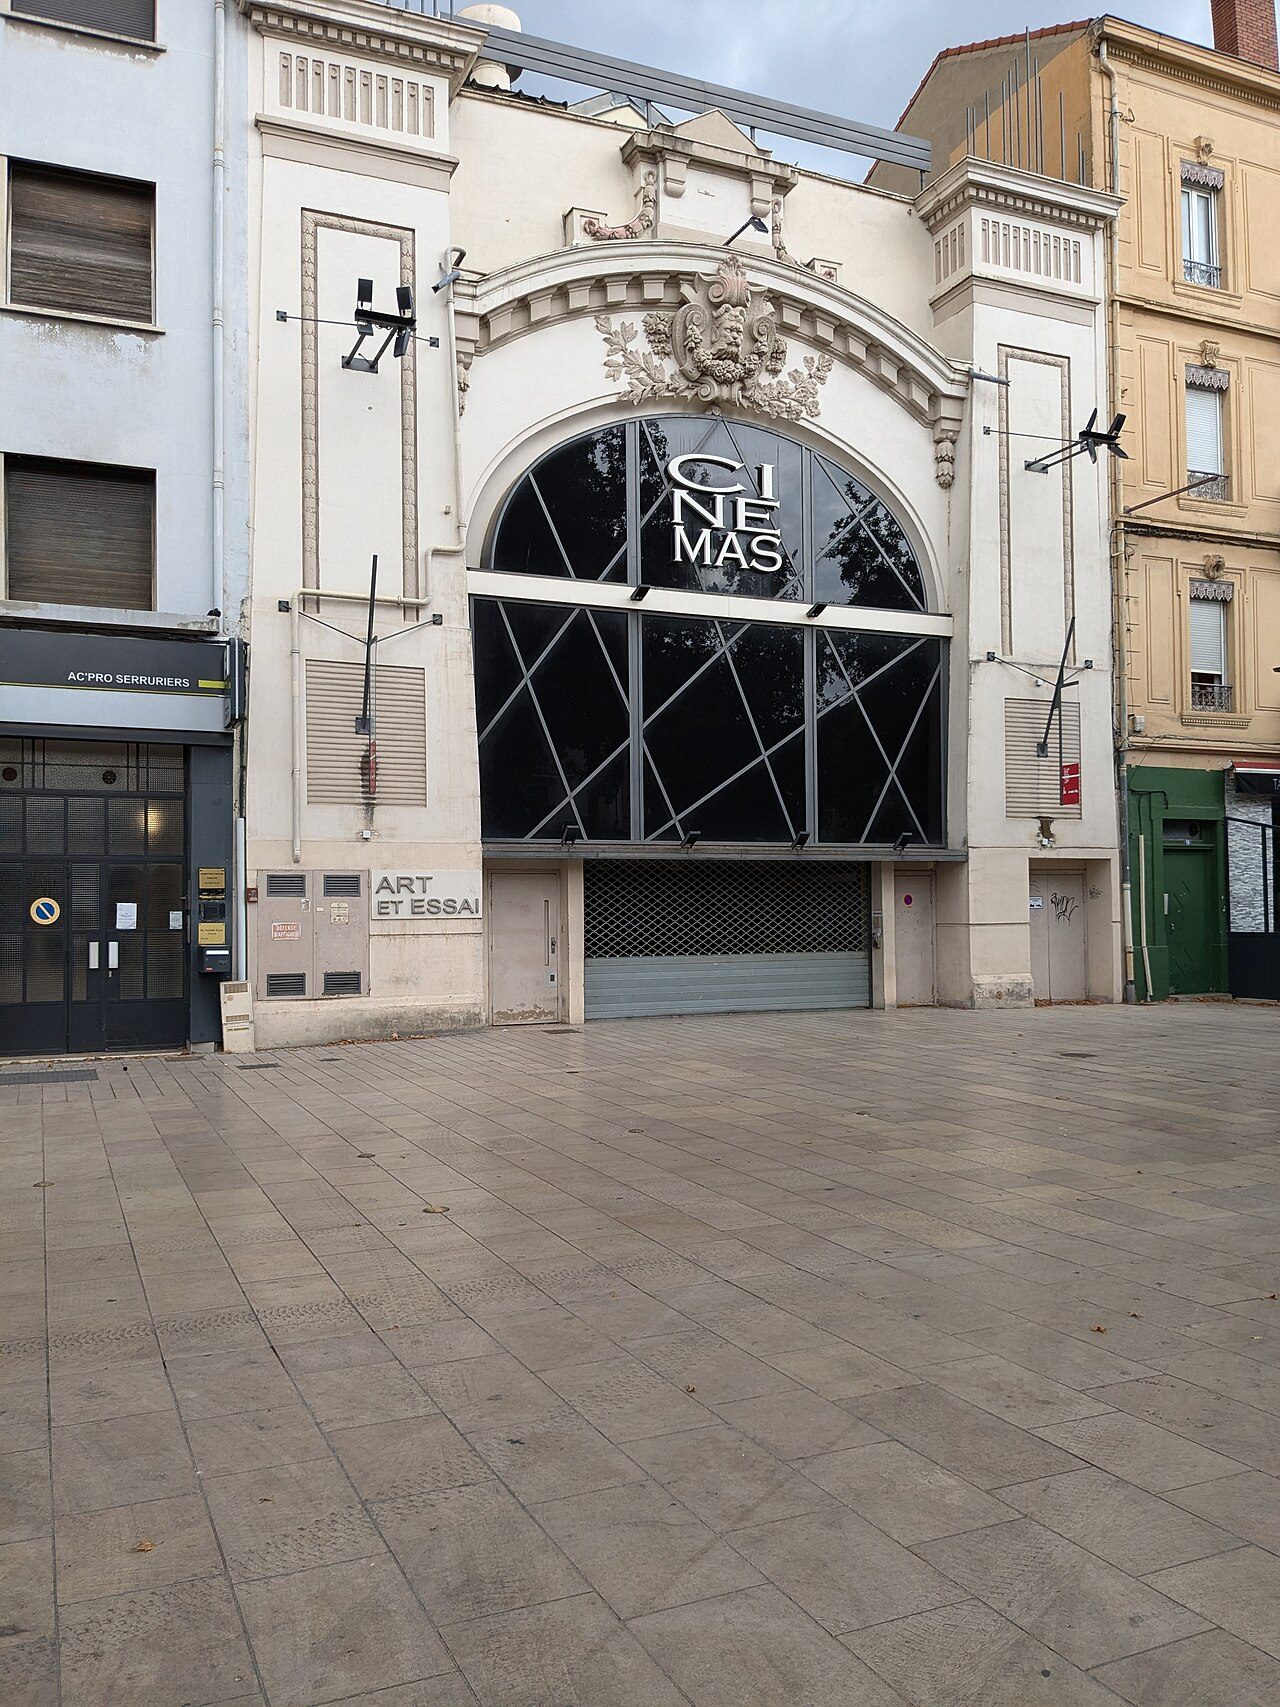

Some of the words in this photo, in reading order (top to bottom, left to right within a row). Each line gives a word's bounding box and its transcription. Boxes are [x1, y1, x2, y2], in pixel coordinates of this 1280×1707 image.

[666, 453, 775, 500] CI
[671, 488, 781, 537] NE
[672, 524, 783, 573] MAS
[67, 671, 113, 683] AC'PRO
[115, 674, 190, 688] SERRURIERS
[375, 876, 433, 894] ART
[377, 900, 404, 915] ET
[411, 898, 479, 914] ESSAI
